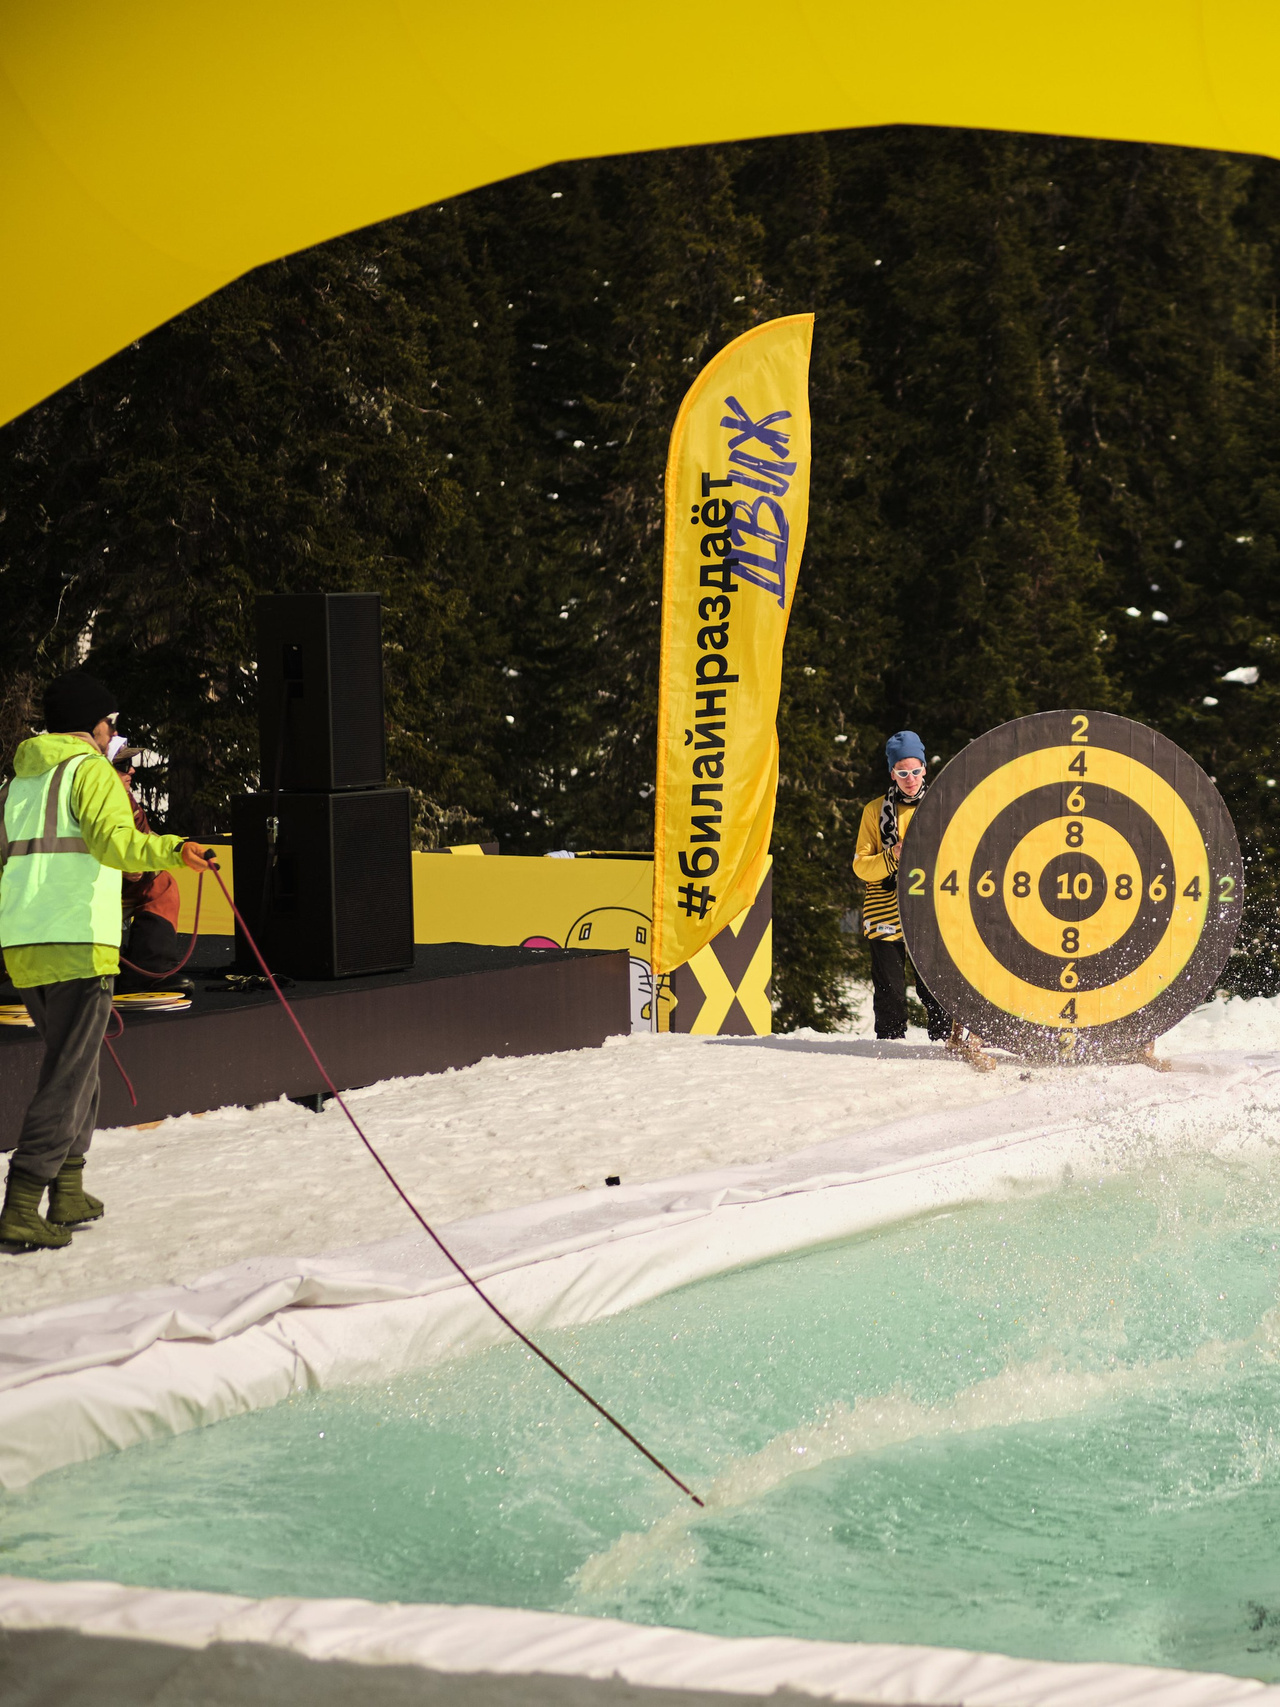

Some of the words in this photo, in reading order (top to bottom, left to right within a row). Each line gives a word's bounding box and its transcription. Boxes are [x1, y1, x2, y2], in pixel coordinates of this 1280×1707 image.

[719, 395, 798, 610] ДВИЖ
[677, 471, 740, 920] #билайнраздаёт
[1070, 714, 1090, 742] 2
[1068, 750, 1088, 777] 4
[1066, 785, 1086, 813] 6
[1065, 821, 1084, 848] 8
[908, 868, 927, 896] 2
[940, 869, 960, 896] 4
[976, 870, 996, 898] 6
[1012, 871, 1031, 898] 8
[1056, 872, 1093, 900] 10
[1114, 873, 1133, 901] 8
[1148, 874, 1168, 902] 6
[1182, 875, 1202, 902] 4
[1217, 876, 1236, 902] 2
[1061, 926, 1080, 954] 8
[1059, 962, 1079, 990] 6
[1059, 997, 1078, 1024] 4
